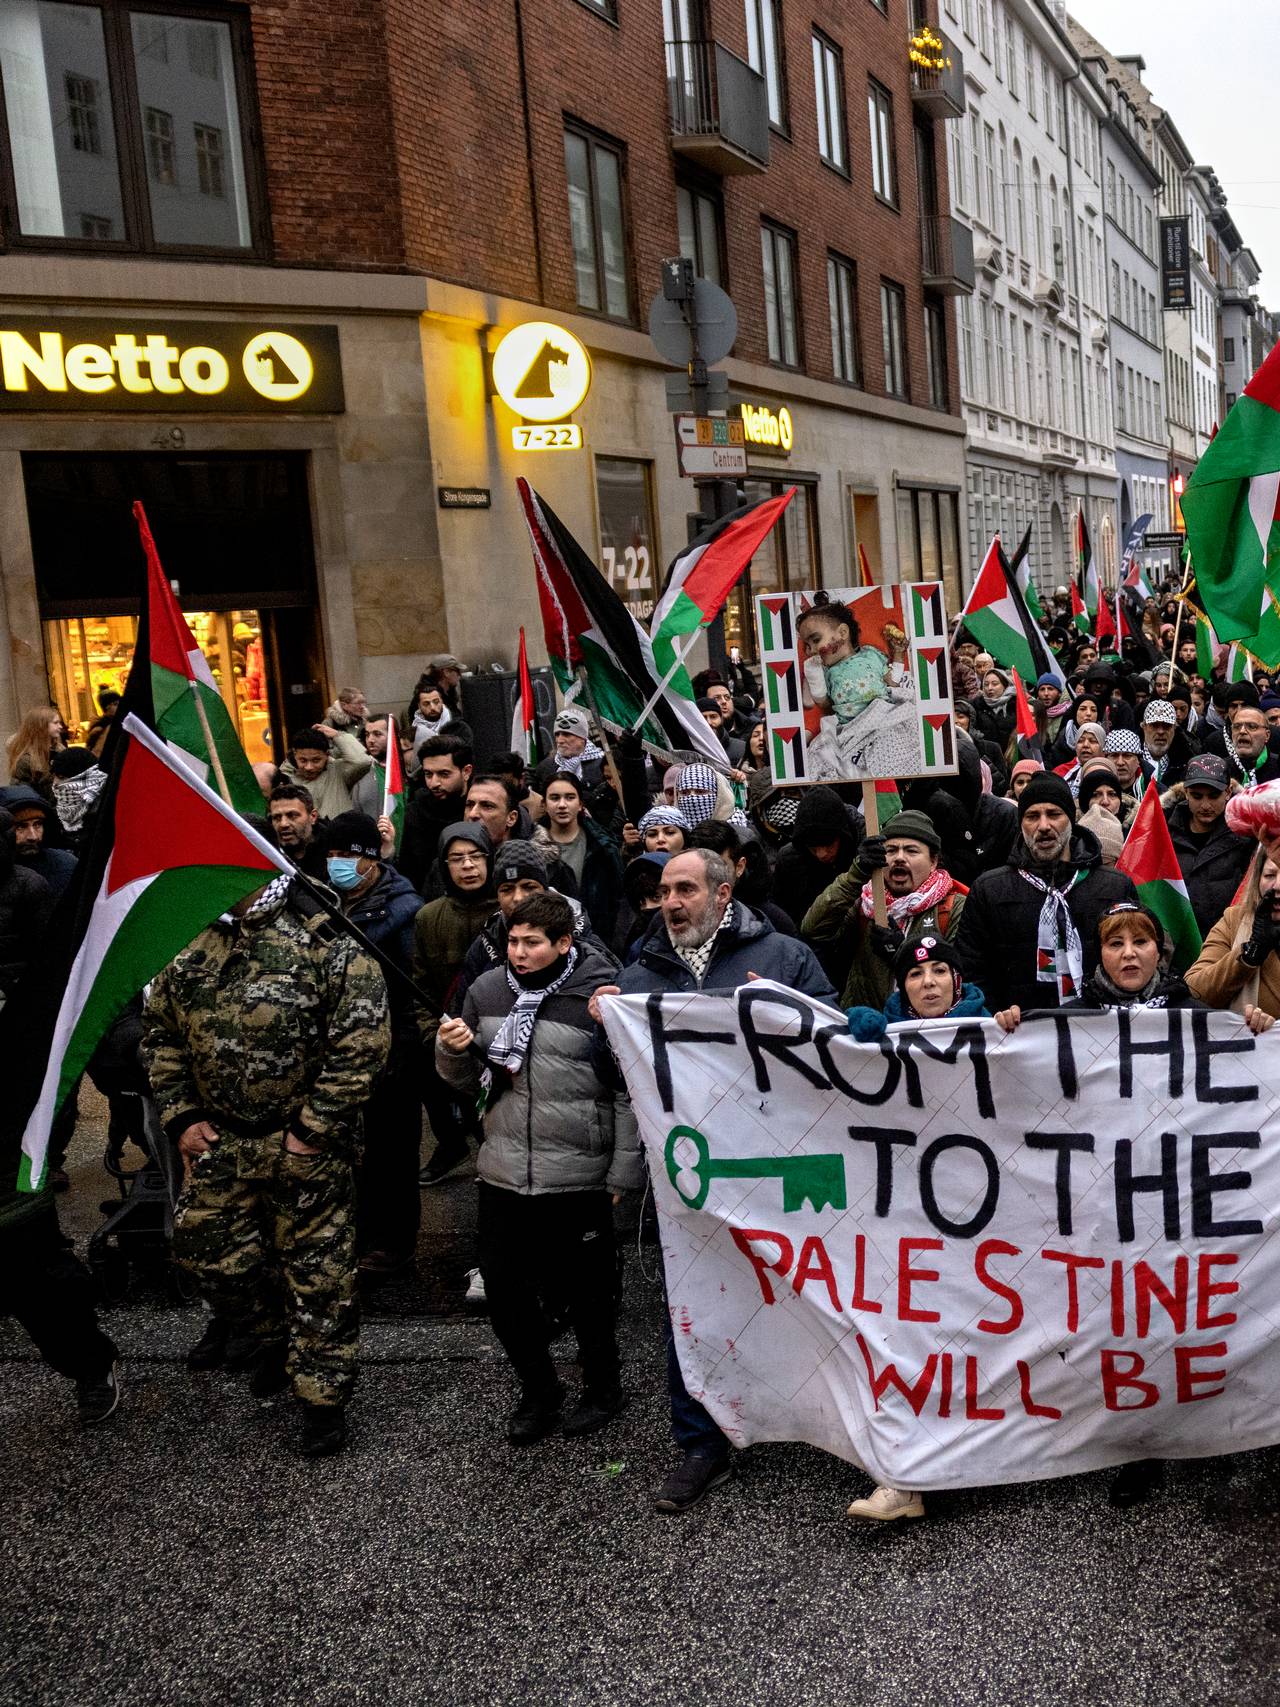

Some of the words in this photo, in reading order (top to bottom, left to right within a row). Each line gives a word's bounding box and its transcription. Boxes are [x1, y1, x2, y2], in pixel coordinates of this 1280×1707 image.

[0, 331, 229, 394] Netto
[519, 430, 572, 446] 7-22
[741, 403, 779, 446] Netto
[713, 450, 743, 467] Centrum
[444, 491, 457, 502] Store
[602, 546, 650, 589] 7-22
[646, 987, 997, 1120] FROM
[1020, 1008, 1260, 1104] THE
[847, 1125, 1001, 1240] TO
[1024, 1131, 1264, 1244] THE
[729, 1226, 1239, 1339] PALESTINE
[856, 1333, 1062, 1421] WILL
[1100, 1342, 1228, 1412] BE
